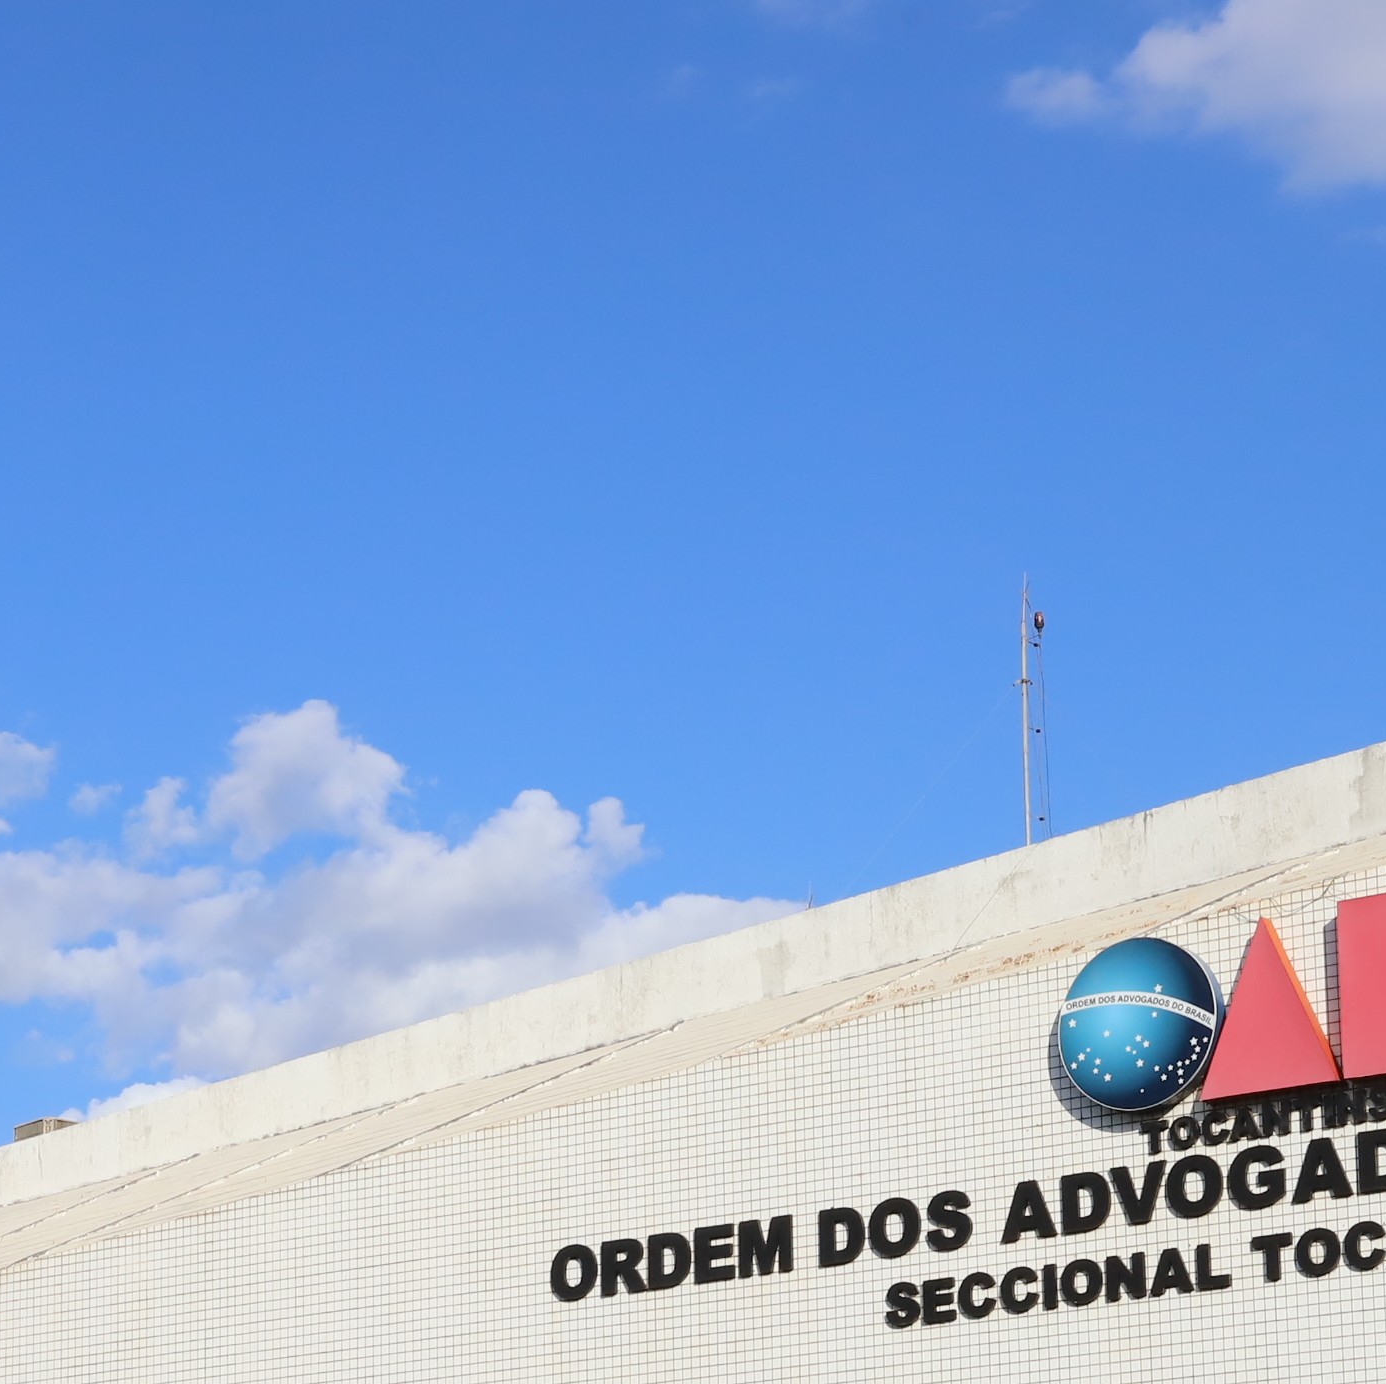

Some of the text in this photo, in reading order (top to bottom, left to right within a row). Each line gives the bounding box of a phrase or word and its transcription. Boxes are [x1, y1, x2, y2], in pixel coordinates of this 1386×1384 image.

[1065, 999, 1096, 1010] ORDEM
[1117, 995, 1170, 1007] ADVOGADOS
[1172, 1001, 1184, 1011] DO
[1185, 1005, 1212, 1025] BRASIL
[550, 1215, 793, 1302] ORDEM
[818, 1190, 972, 1268] DOS
[886, 1243, 1232, 1330] SECCIONAL
